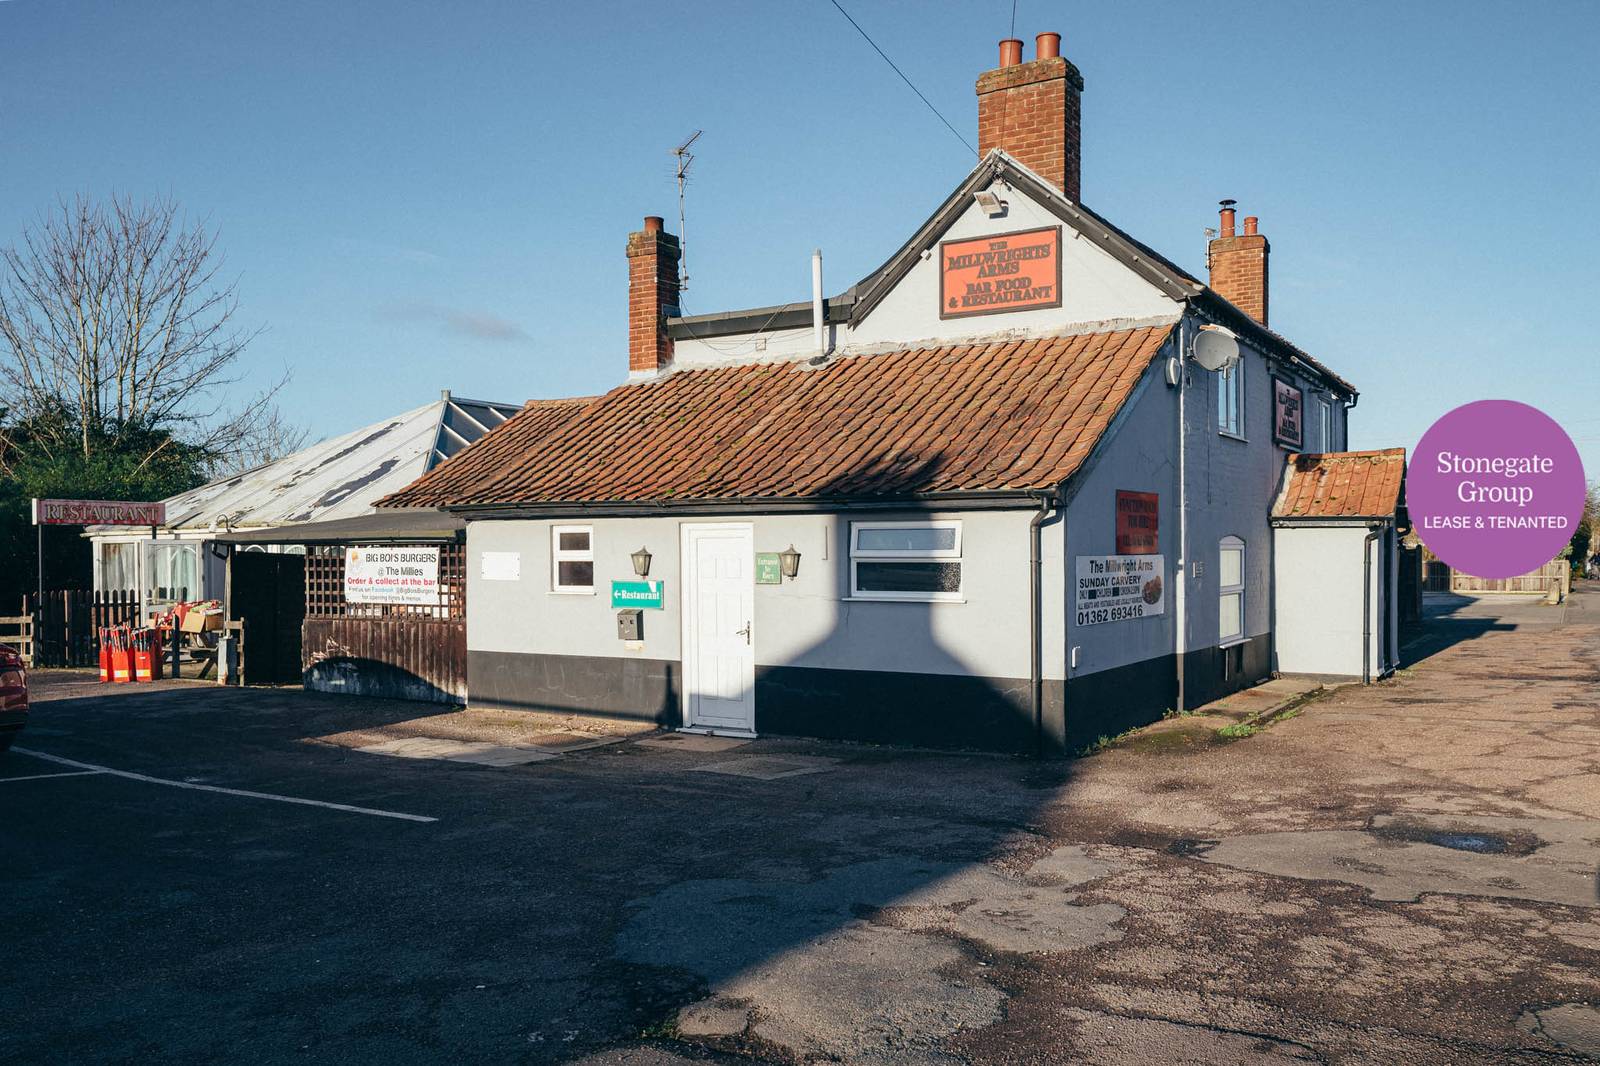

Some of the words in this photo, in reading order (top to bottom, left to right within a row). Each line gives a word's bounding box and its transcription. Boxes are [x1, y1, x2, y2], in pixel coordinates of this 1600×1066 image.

[947, 245, 1051, 271] MILLWRIGHTS
[977, 261, 1020, 278] ARMS
[966, 281, 992, 295] BAR
[995, 277, 1032, 291] FOOD
[949, 297, 958, 308] &
[961, 286, 1052, 307] RESTAURANT
[46, 504, 159, 520] RESTAURANT
[366, 553, 378, 563] BIG
[400, 553, 437, 563] BURGERS
[386, 566, 399, 576] The
[400, 566, 424, 576] Millies
[1090, 560, 1103, 573] The
[1106, 560, 1136, 574] Millwright
[1138, 559, 1153, 571] Arms
[347, 577, 366, 585] Order
[368, 577, 373, 585] &
[375, 577, 400, 586] collect
[401, 578, 408, 586] at
[410, 578, 422, 586] the
[423, 578, 436, 586] bar
[1080, 577, 1110, 589] SUNDAY
[1111, 575, 1141, 586] CARVERY
[622, 590, 660, 600] Restaurant
[1078, 609, 1108, 625] 01362
[1111, 605, 1143, 620] 693416
